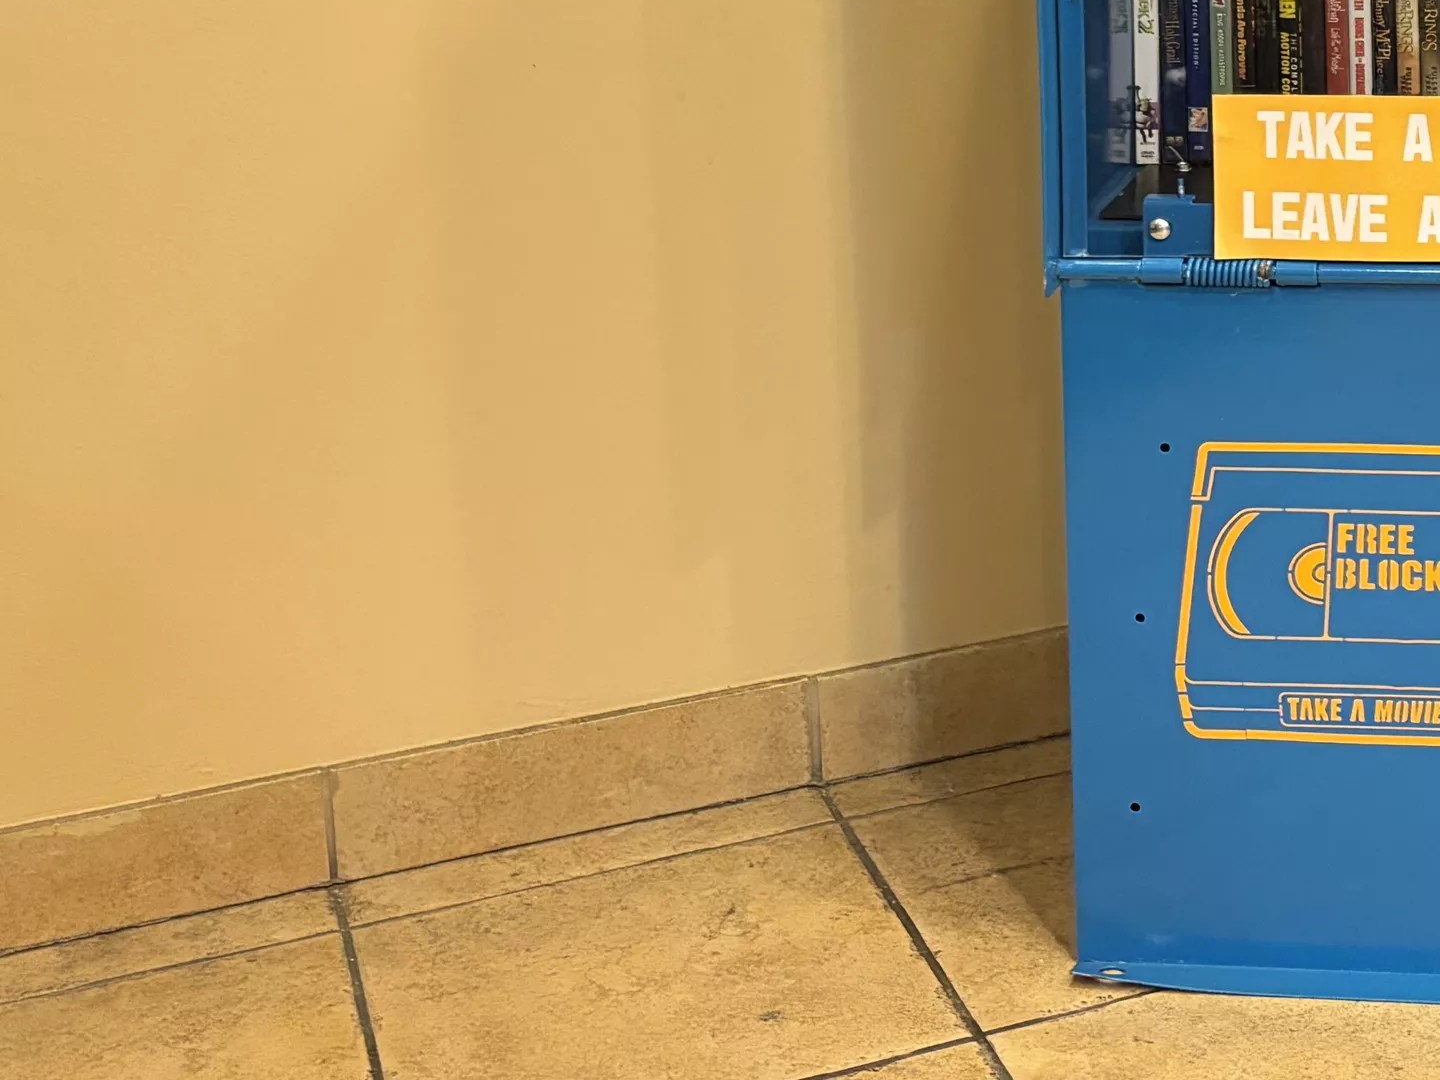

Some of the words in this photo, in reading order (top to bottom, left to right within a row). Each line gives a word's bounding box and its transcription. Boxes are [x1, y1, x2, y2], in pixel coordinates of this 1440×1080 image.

[1138, 18, 1155, 35] 2
[1163, 20, 1180, 42] Holy
[1191, 0, 1199, 29] SPECIAL
[1236, 19, 1246, 38] Are
[1421, 8, 1438, 51] RINGS
[1290, 33, 1298, 51] THE
[1398, 10, 1414, 54] RINGS
[1166, 41, 1181, 64] Grail
[1191, 32, 1199, 66] EDITION
[1237, 38, 1248, 80] Forever
[1280, 32, 1291, 75] MOTION
[1375, 29, 1393, 76] McPhee
[1258, 111, 1373, 161] TAKE
[1403, 114, 1433, 162] A
[1244, 191, 1388, 243] LEAVE
[1336, 523, 1415, 556] FREE
[1287, 697, 1342, 721] TAKE
[1350, 699, 1366, 723] A
